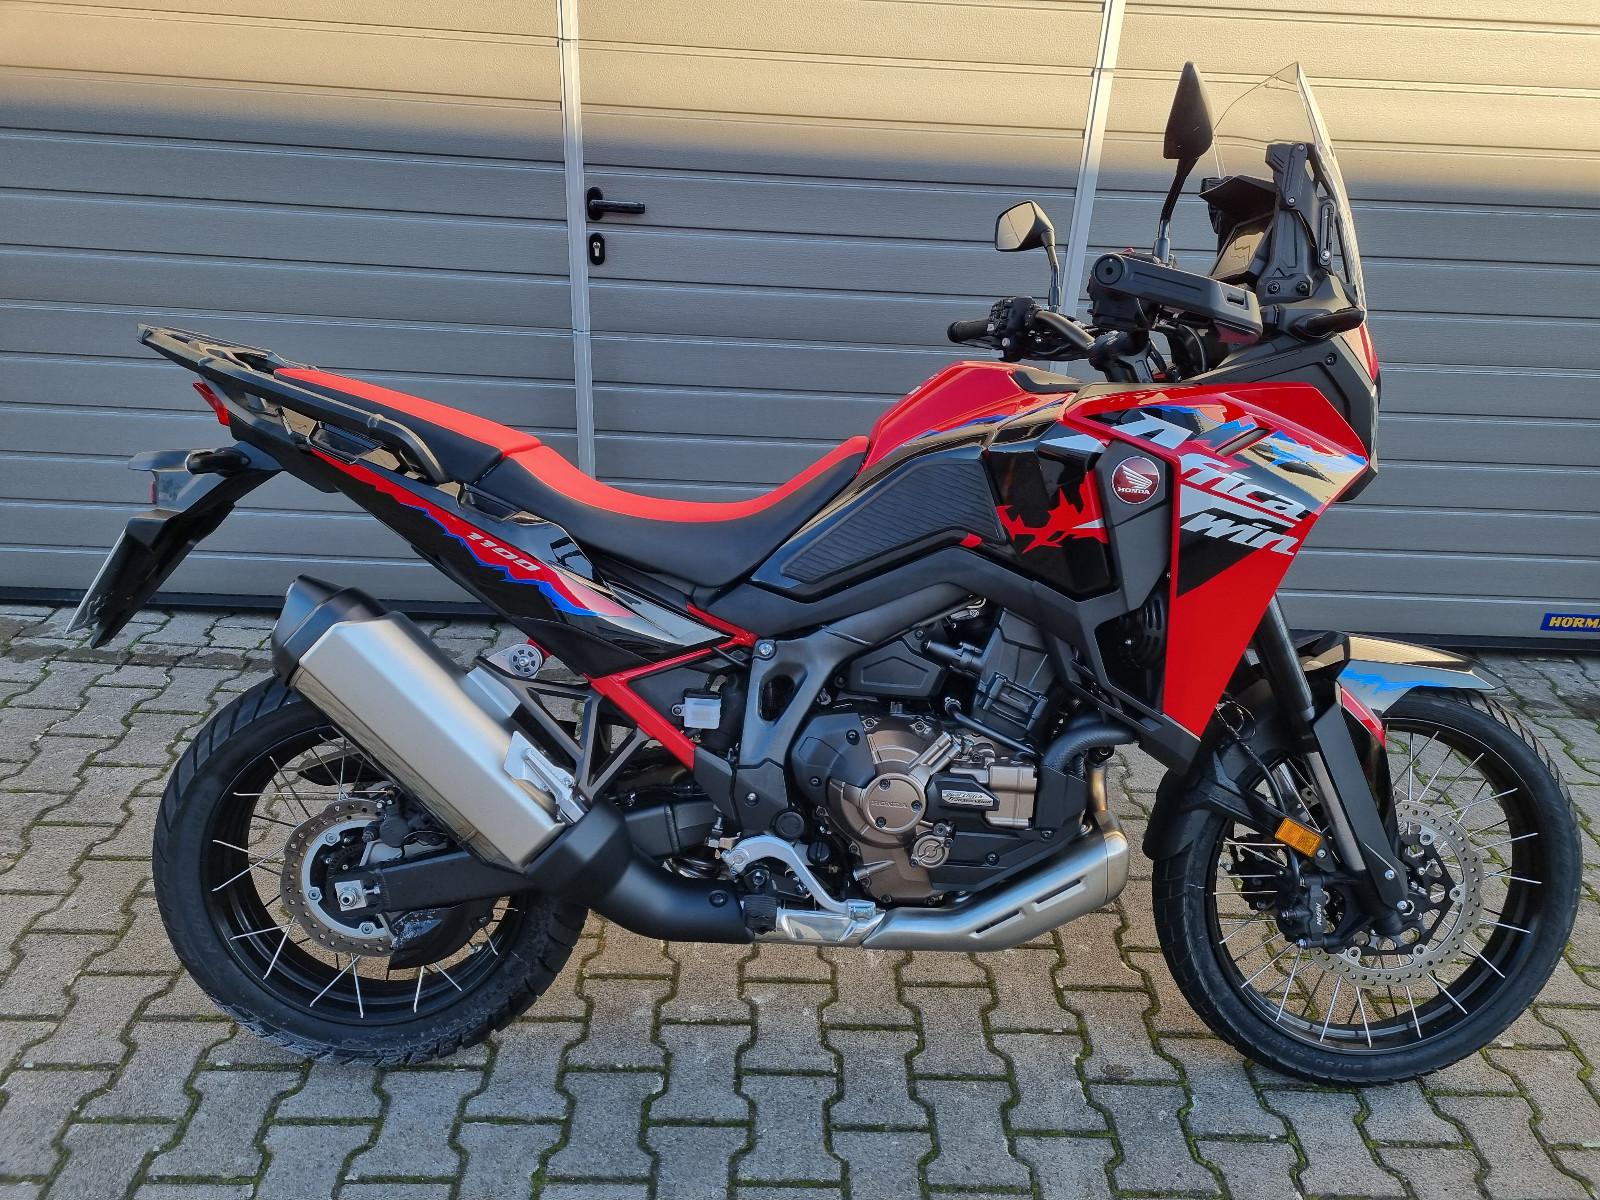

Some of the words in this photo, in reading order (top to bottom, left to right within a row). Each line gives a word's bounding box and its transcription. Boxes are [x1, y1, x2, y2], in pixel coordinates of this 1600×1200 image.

[1117, 486, 1151, 495] HONDA
[467, 532, 541, 571] 1100
[1549, 616, 1600, 628] HÖRM
